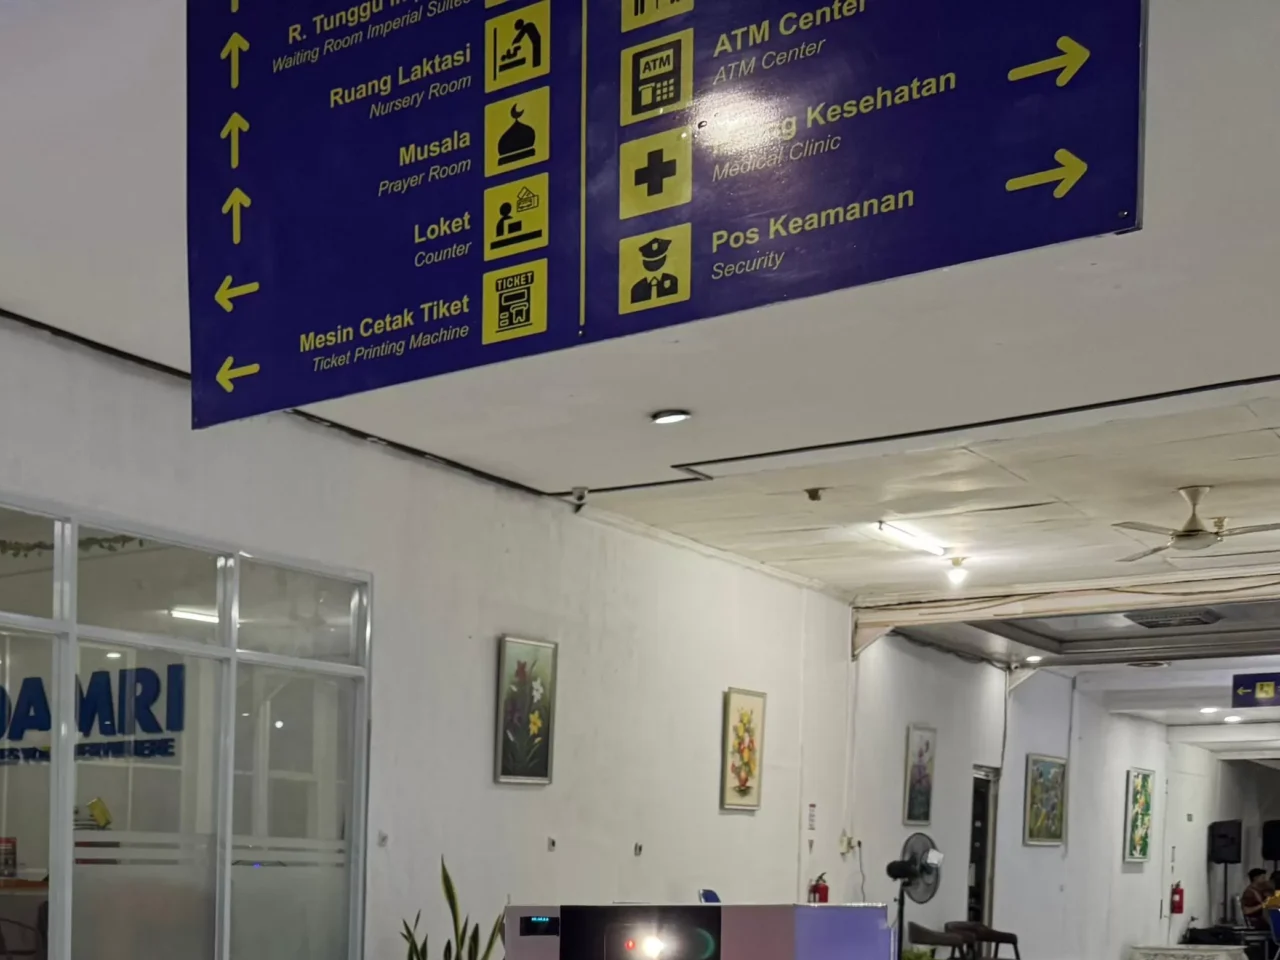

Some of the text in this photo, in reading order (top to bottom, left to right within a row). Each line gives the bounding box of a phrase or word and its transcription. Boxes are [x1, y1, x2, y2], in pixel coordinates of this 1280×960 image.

[272, 47, 319, 73] Waiting
[323, 30, 363, 55] Room
[366, 5, 423, 39] Imperial
[288, 0, 383, 44] R. Tunggu
[711, 20, 769, 57] ATM
[330, 43, 471, 108] Ruang Laktasi
[642, 54, 671, 75] ATM
[712, 39, 826, 85] ATM Center
[369, 75, 472, 119] Nursery Room
[806, 72, 956, 129] Kesehatan
[399, 130, 471, 166] Musala
[712, 146, 784, 182] Medical
[789, 134, 842, 160] Clinic
[378, 159, 471, 197] Prayer Room
[414, 212, 471, 244] Loket
[712, 189, 915, 253] Pos Keamanan
[414, 241, 472, 267] Counter
[711, 250, 785, 280] Security
[496, 272, 534, 291] TICKET
[299, 294, 469, 353] Mesin Cetak Tiket
[313, 323, 469, 372] Ticket Printing Machine
